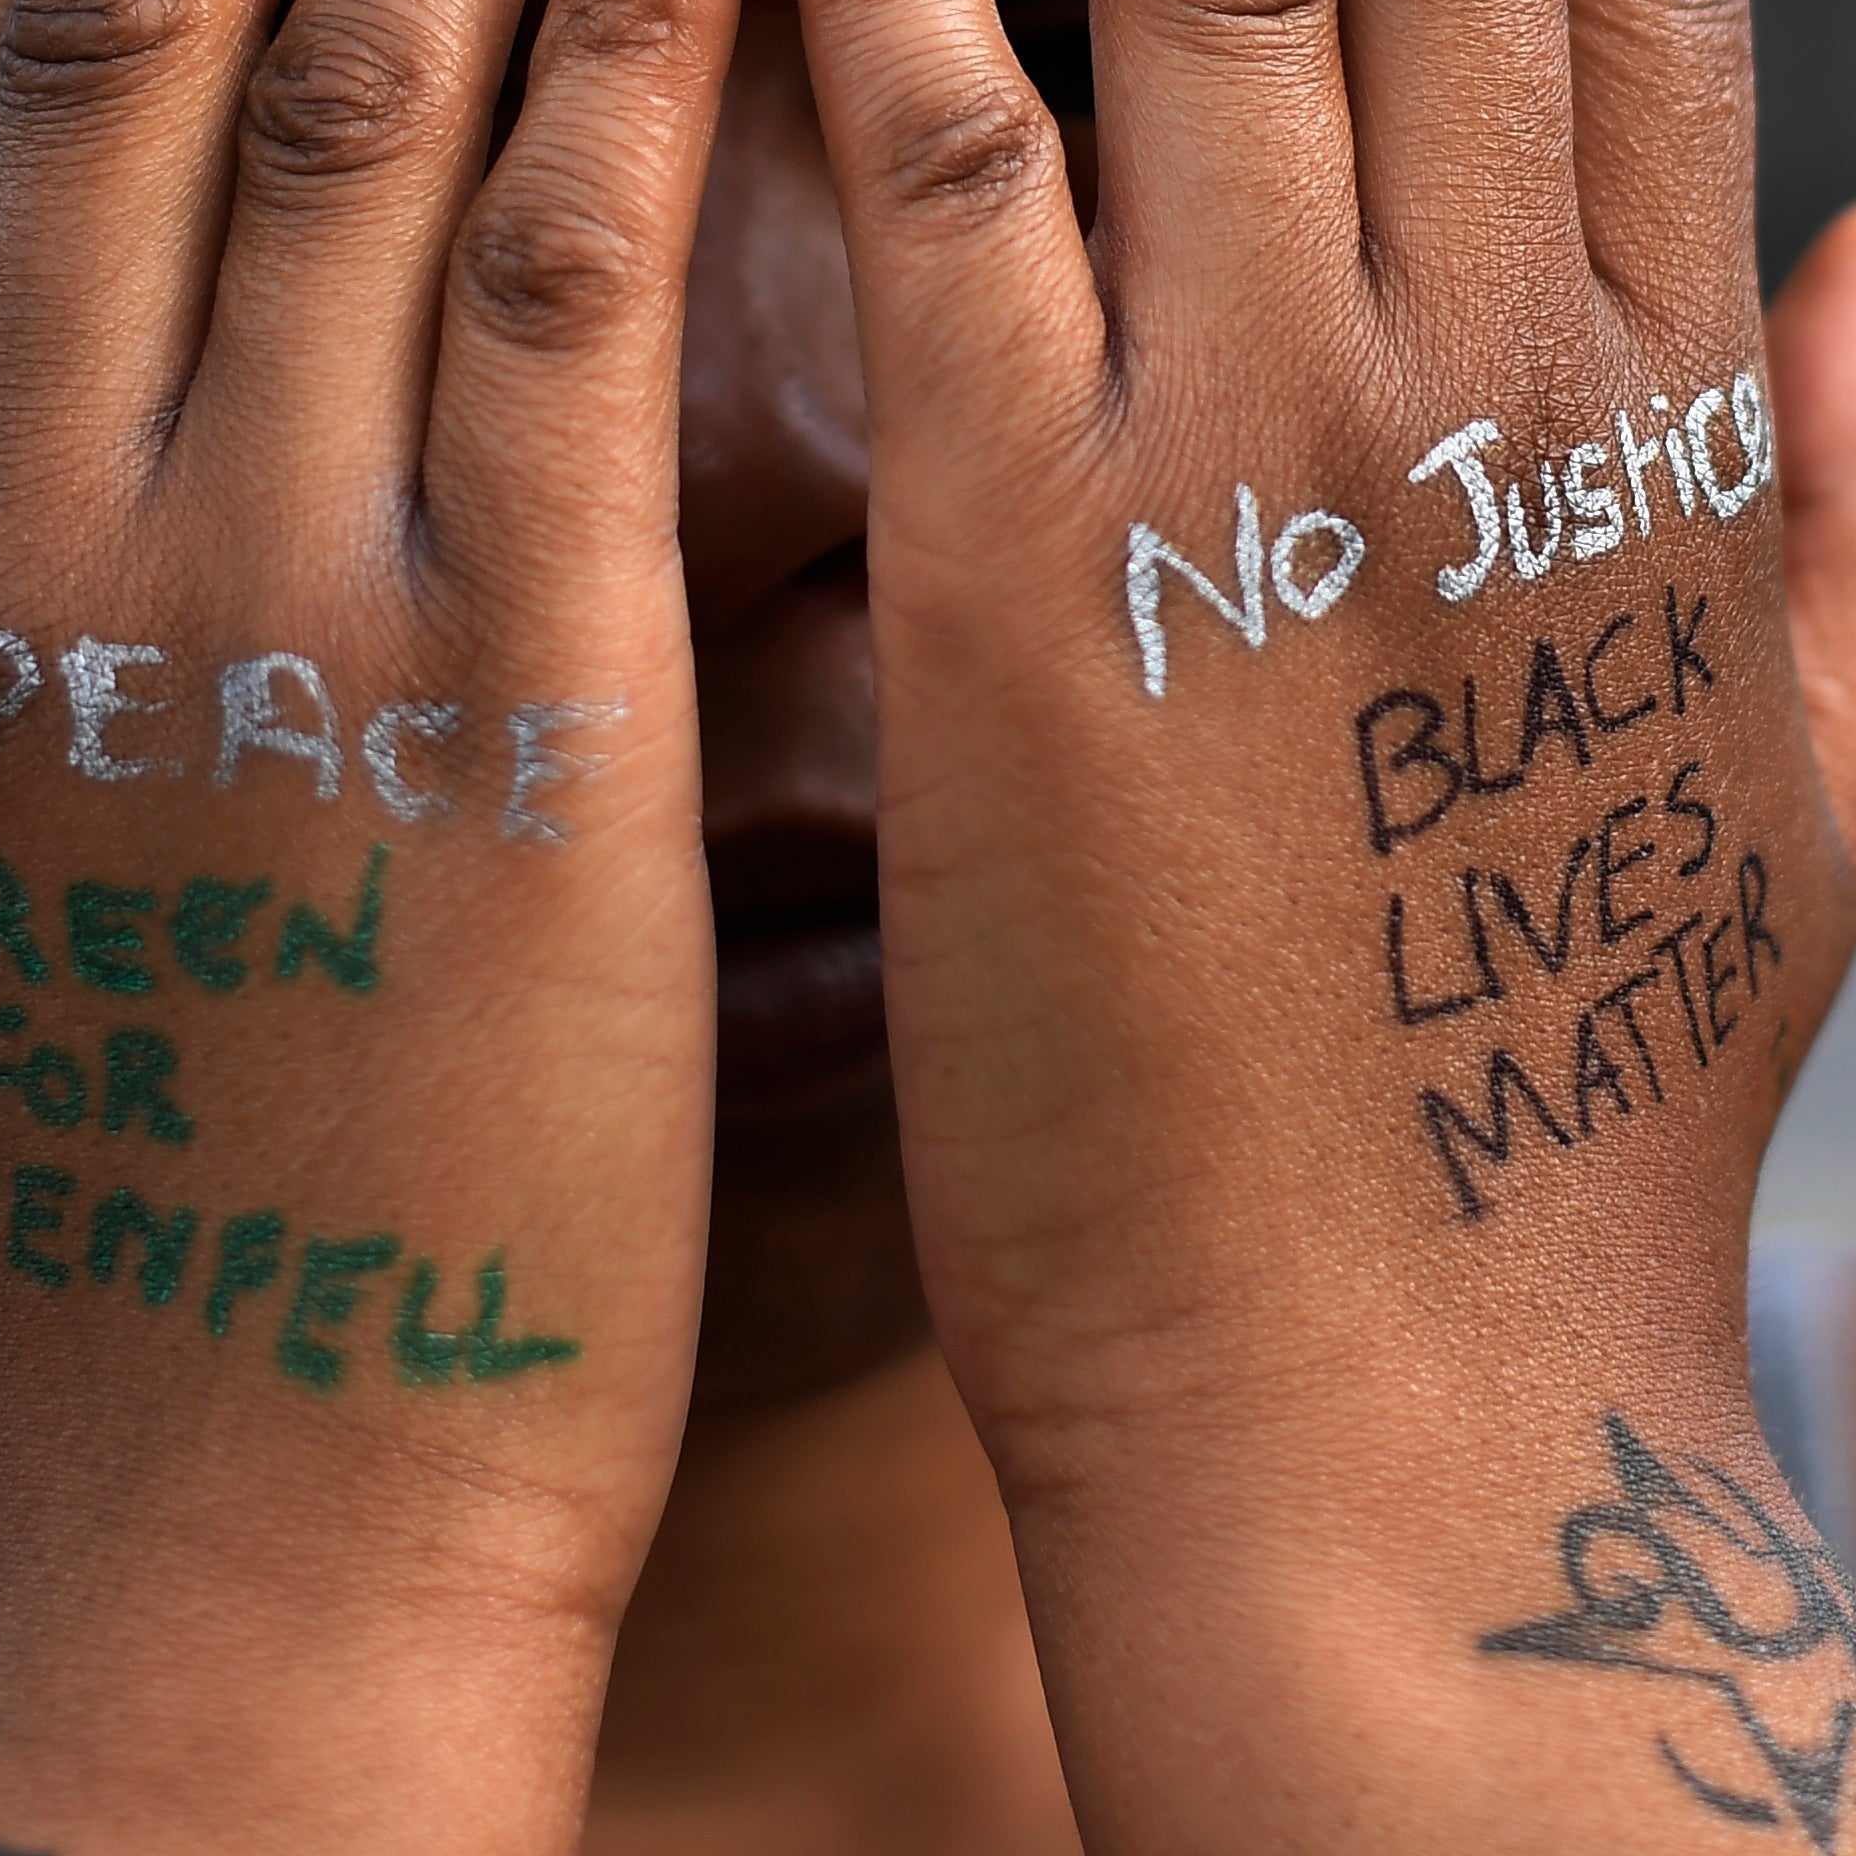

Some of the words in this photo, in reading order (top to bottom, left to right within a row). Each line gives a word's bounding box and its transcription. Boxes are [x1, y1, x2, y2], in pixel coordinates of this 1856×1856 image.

[1127, 482, 1366, 699] No
[1354, 585, 1717, 855] BLACK
[1386, 761, 1716, 1026] LIVES
[1418, 852, 1783, 1223] MATTER
